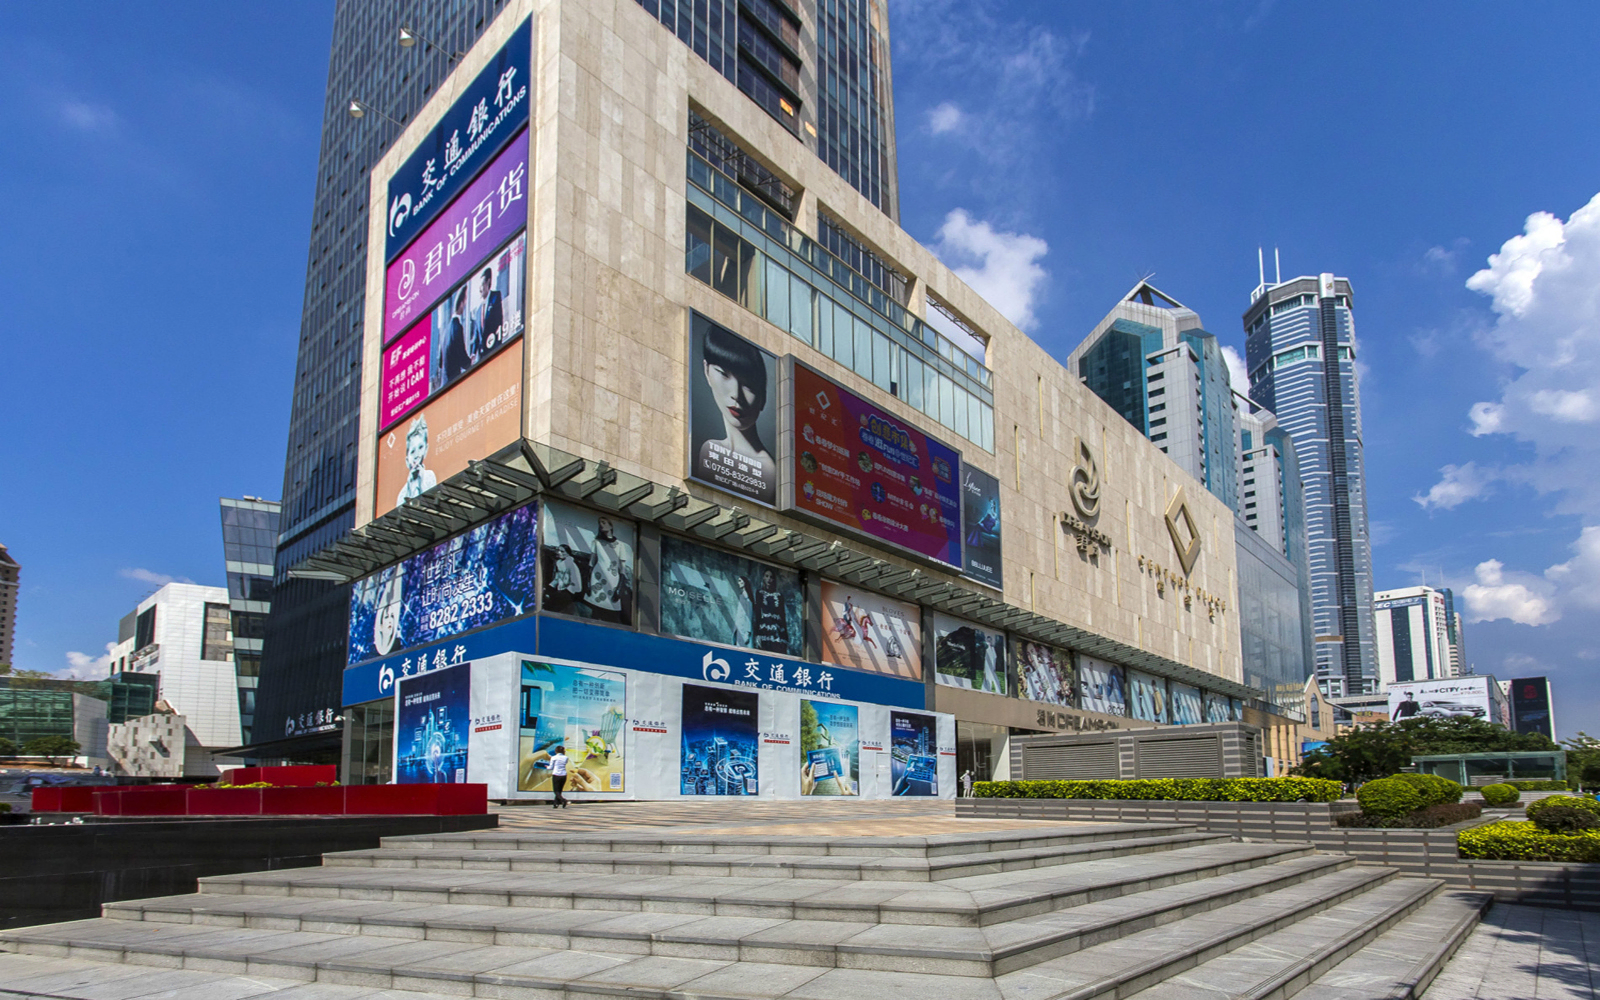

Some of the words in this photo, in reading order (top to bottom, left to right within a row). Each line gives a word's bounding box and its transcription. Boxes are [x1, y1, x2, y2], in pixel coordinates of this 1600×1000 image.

[421, 66, 517, 196] 交通銀行
[412, 191, 435, 217] BANK
[436, 174, 448, 191] OF
[449, 85, 527, 177] COMMUNICATIONS
[422, 161, 525, 287] 君尚百货
[411, 367, 425, 386] CAN
[486, 396, 519, 425] PARADISE
[708, 440, 731, 457] TONY
[732, 451, 762, 470] STUDIO
[815, 497, 835, 511] SHOW
[422, 548, 465, 586] 世纪汇
[429, 603, 459, 630] 8282
[461, 591, 494, 620] 2333
[401, 643, 467, 678] 交通銀行
[743, 657, 835, 691] 交通銀行
[734, 679, 758, 689] BANK
[761, 683, 773, 691] OF
[775, 685, 841, 700] COMMUNICATIONS
[1439, 686, 1460, 694] CITY
